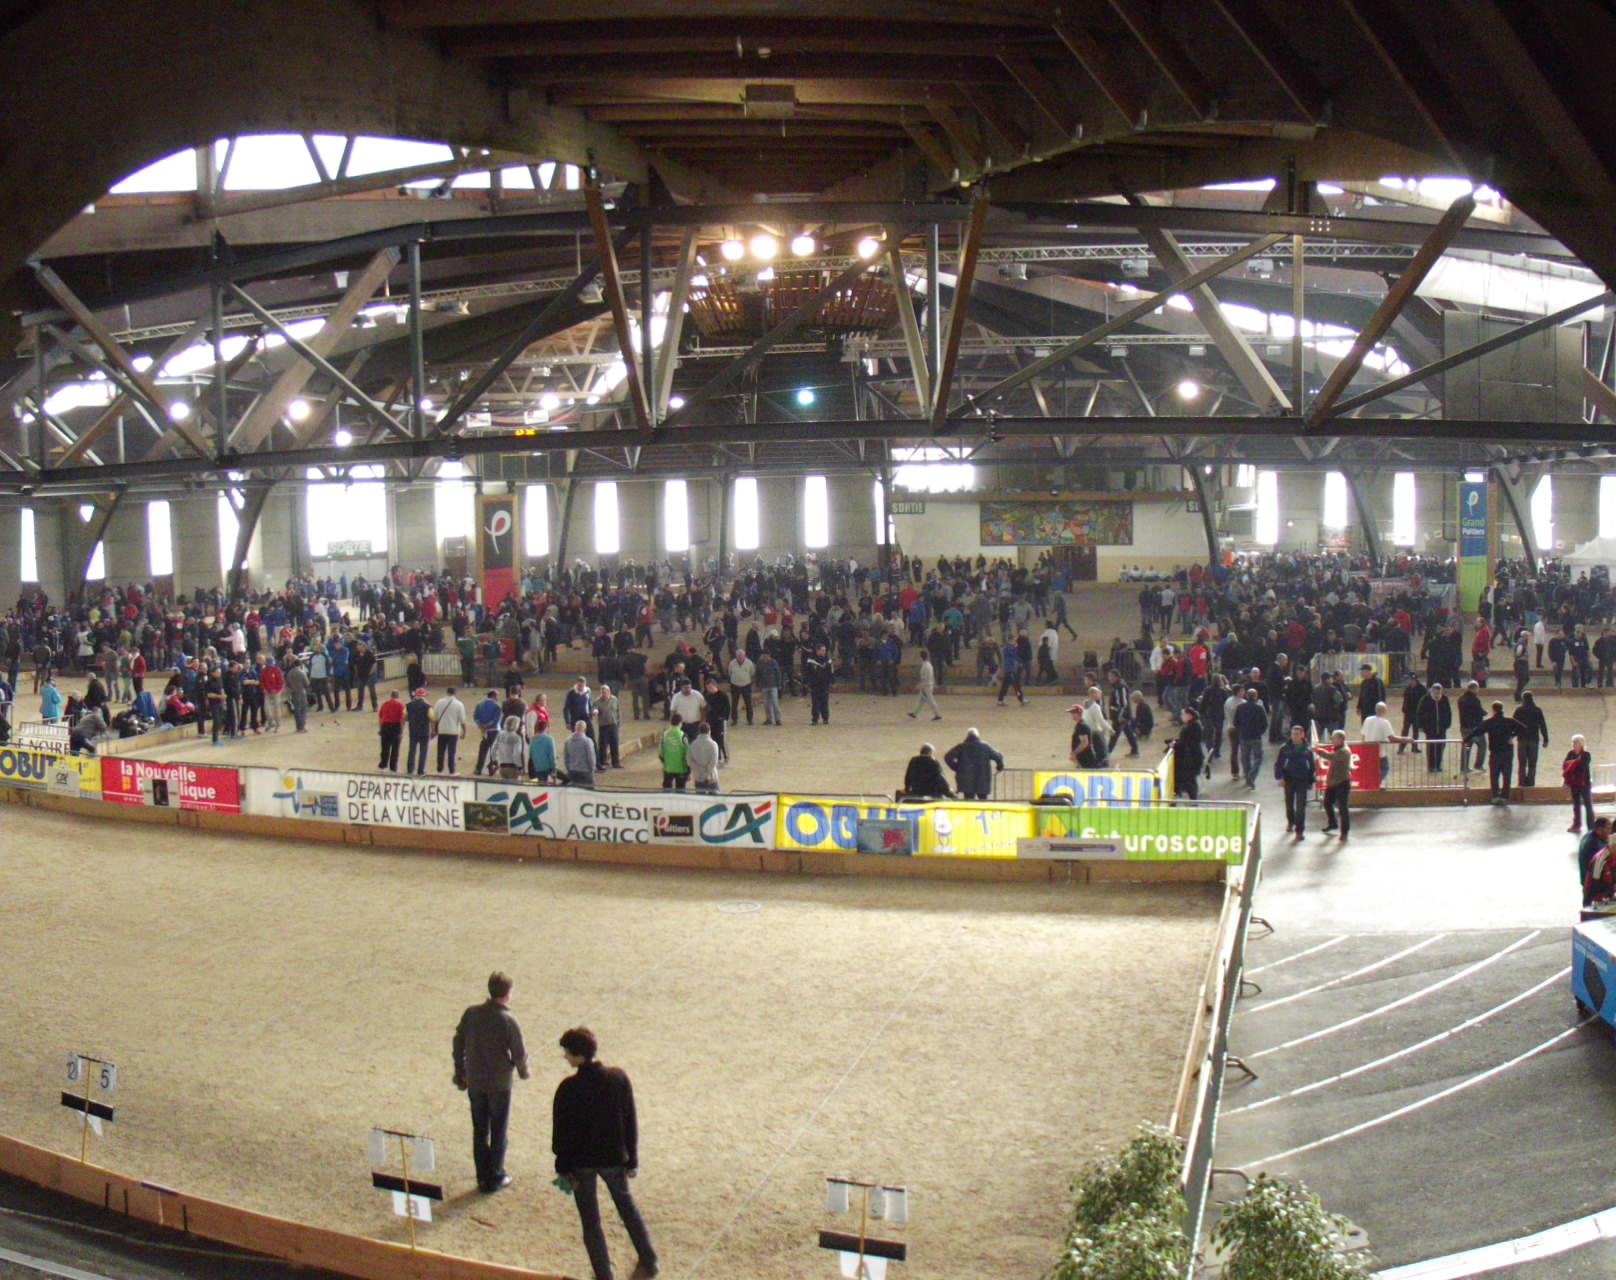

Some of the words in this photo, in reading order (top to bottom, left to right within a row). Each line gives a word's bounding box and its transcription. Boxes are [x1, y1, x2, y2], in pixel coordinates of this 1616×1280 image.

[121, 760, 133, 776] la
[135, 762, 197, 782] Nouvelle
[346, 779, 460, 804] DEPARTEMENT
[348, 802, 369, 821] DE
[373, 804, 392, 823] LA
[396, 805, 461, 828] VIENNE
[100, 1068, 111, 1088] 5
